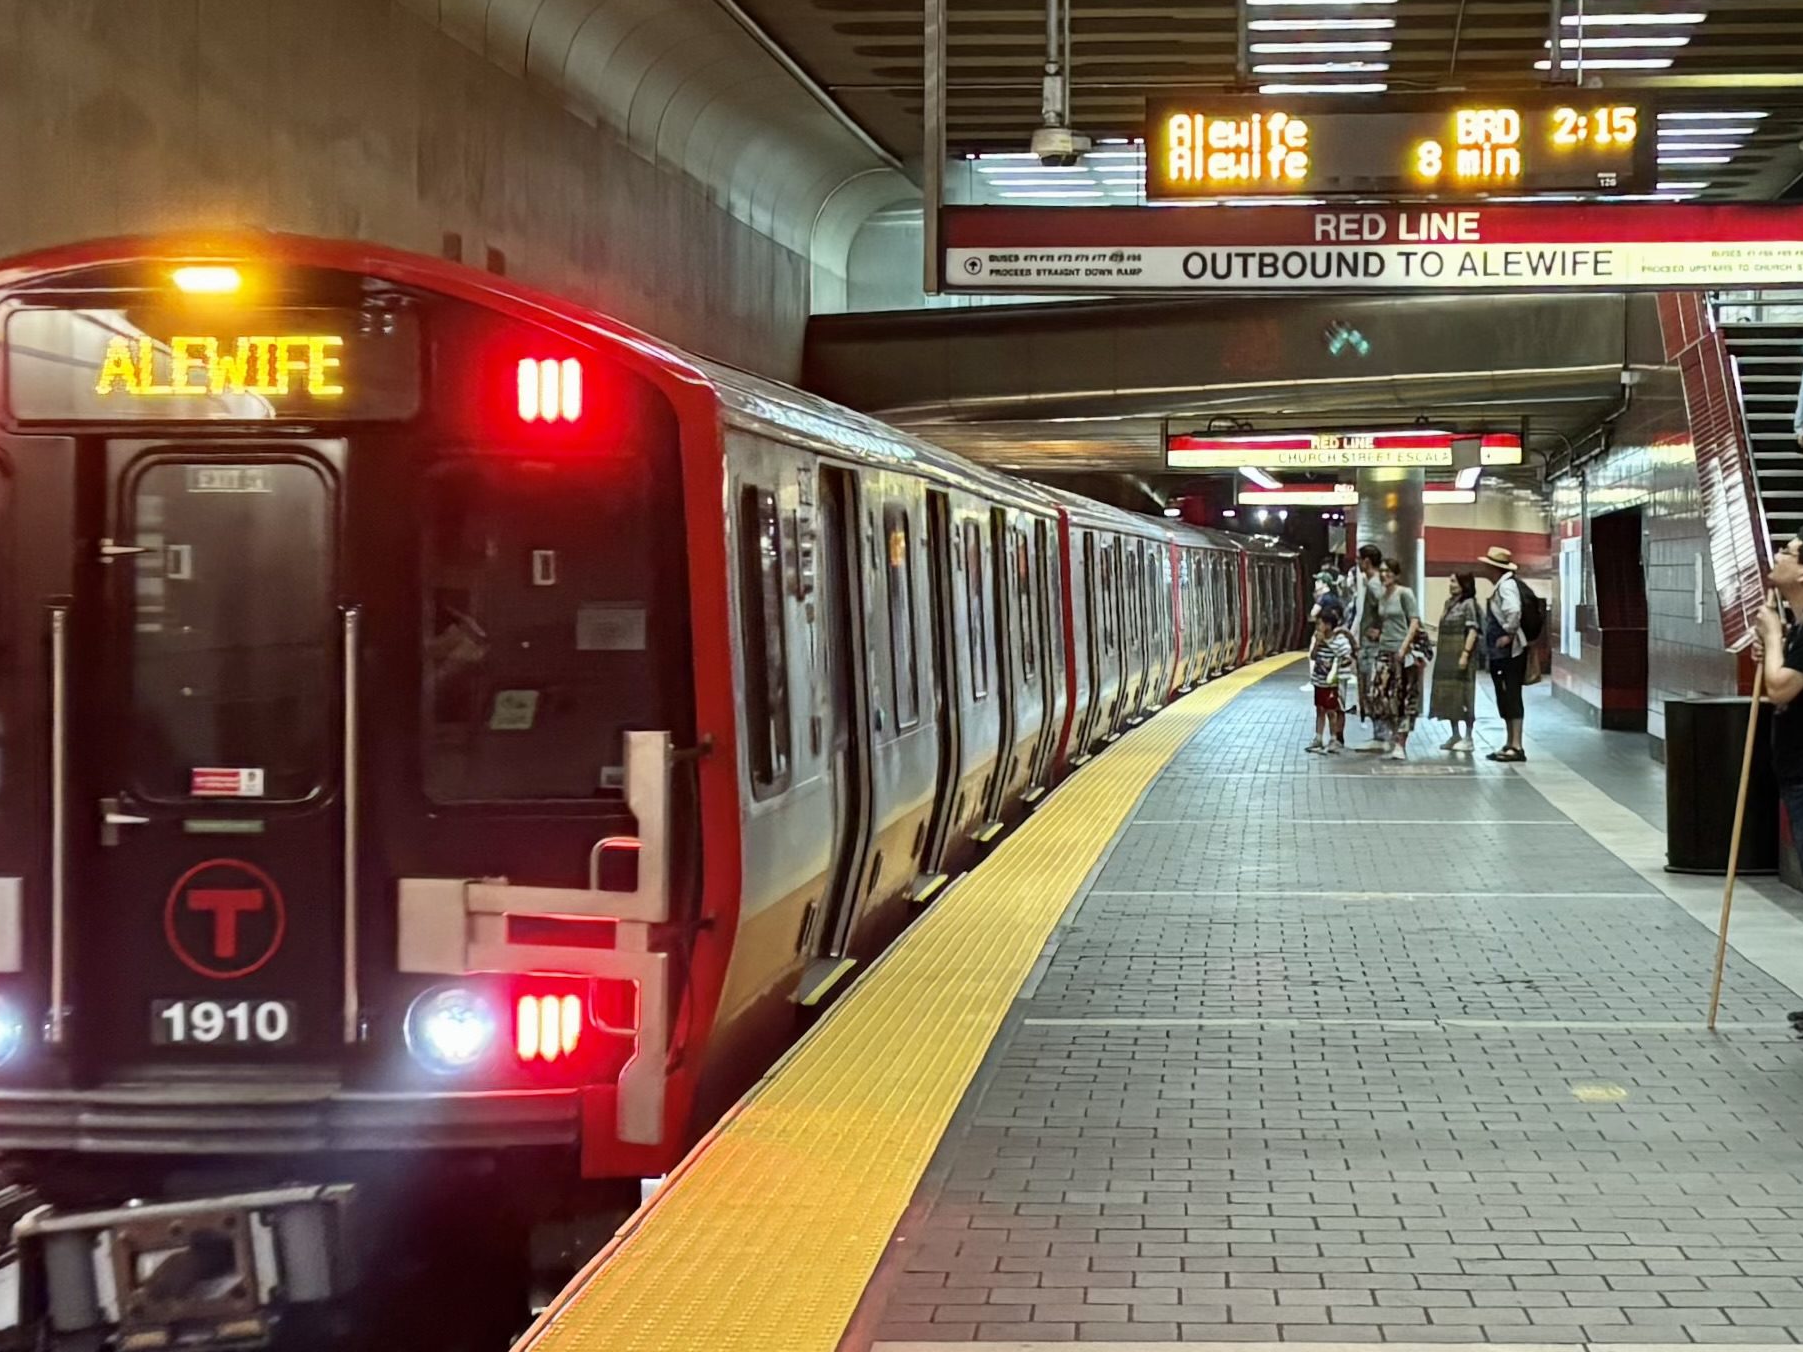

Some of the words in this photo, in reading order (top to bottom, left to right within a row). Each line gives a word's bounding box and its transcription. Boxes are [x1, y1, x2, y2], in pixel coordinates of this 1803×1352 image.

[1169, 112, 1308, 149] Alewife
[1456, 109, 1520, 145] BRD
[1553, 107, 1637, 144] 2:15
[1169, 145, 1308, 180] Alewife
[1418, 140, 1442, 177] 8
[1456, 142, 1521, 177] min
[1314, 213, 1387, 241] RED
[1398, 212, 1481, 240] LINE
[1182, 251, 1385, 279] OUTBOUND
[1397, 251, 1444, 277] TO
[1457, 250, 1614, 277] ALEWIFE
[1738, 263, 1750, 271] TO
[1754, 263, 1793, 271] CHURCH
[95, 335, 343, 395] ALEWIFE
[1278, 451, 1336, 464] CHURCH
[1341, 451, 1391, 464] STREET
[1311, 436, 1340, 449] RED
[1342, 436, 1375, 449] LINE
[187, 889, 264, 959] T
[161, 1000, 289, 1042] 1910
